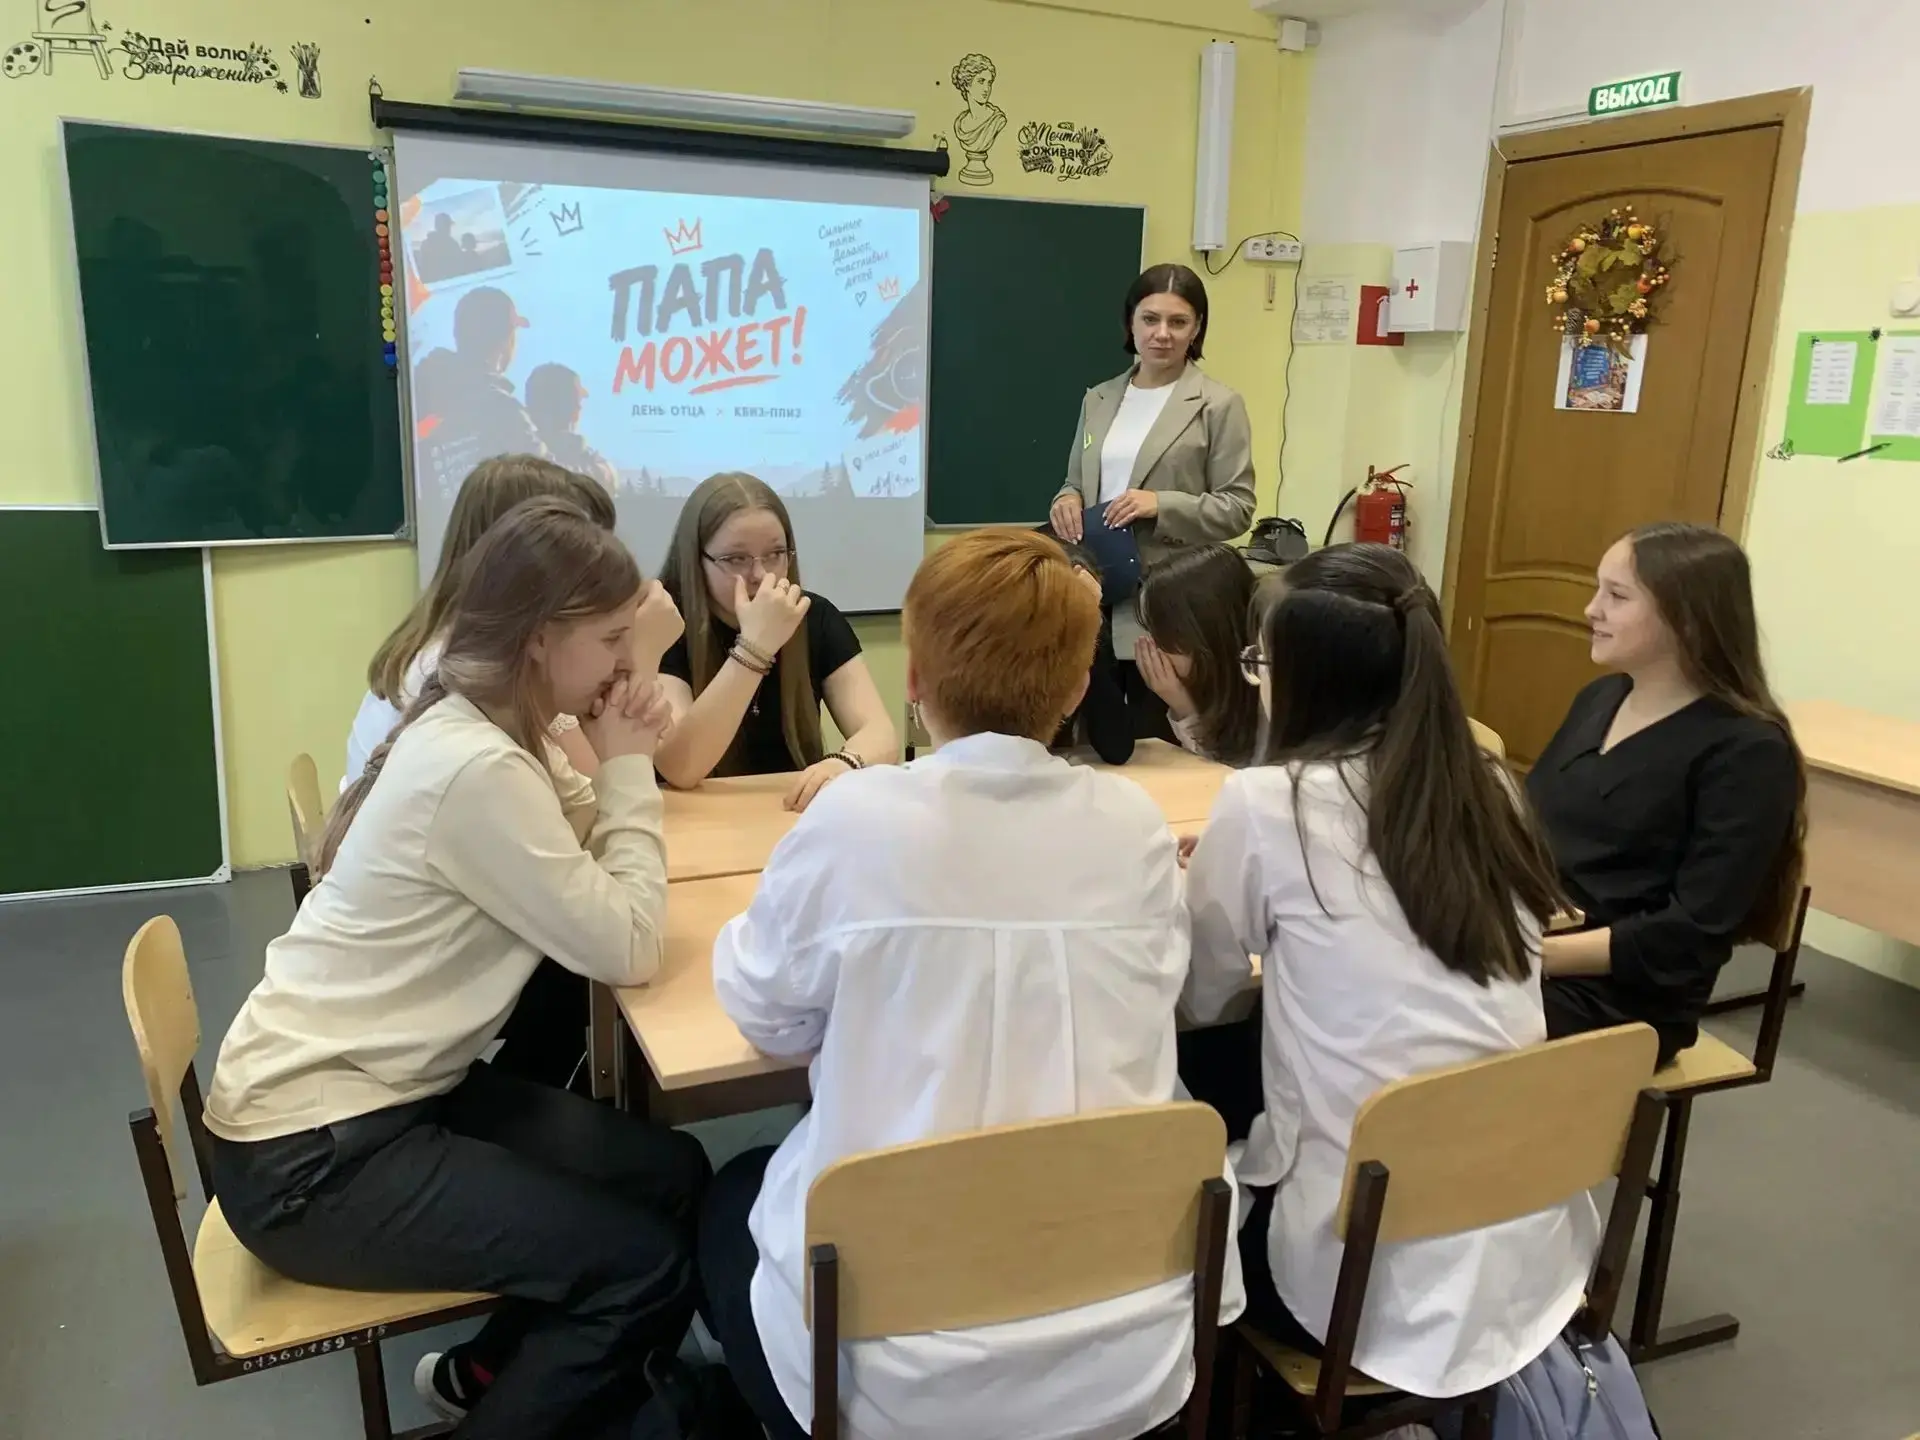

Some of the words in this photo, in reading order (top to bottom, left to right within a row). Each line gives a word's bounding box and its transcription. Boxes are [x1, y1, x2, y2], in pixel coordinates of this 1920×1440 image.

[147, 37, 189, 56] Дай
[196, 45, 248, 61] волю
[1595, 77, 1671, 110] ВЫХОД
[1032, 146, 1093, 159] оживают
[1040, 163, 1055, 175] на
[608, 247, 787, 343] ПАПА
[612, 305, 807, 394] МОЖЕТ!
[632, 405, 665, 417] ДЕНЬ
[671, 405, 705, 418] ОТЦА
[734, 407, 802, 419] КВИЗ-ПЛИЗ
